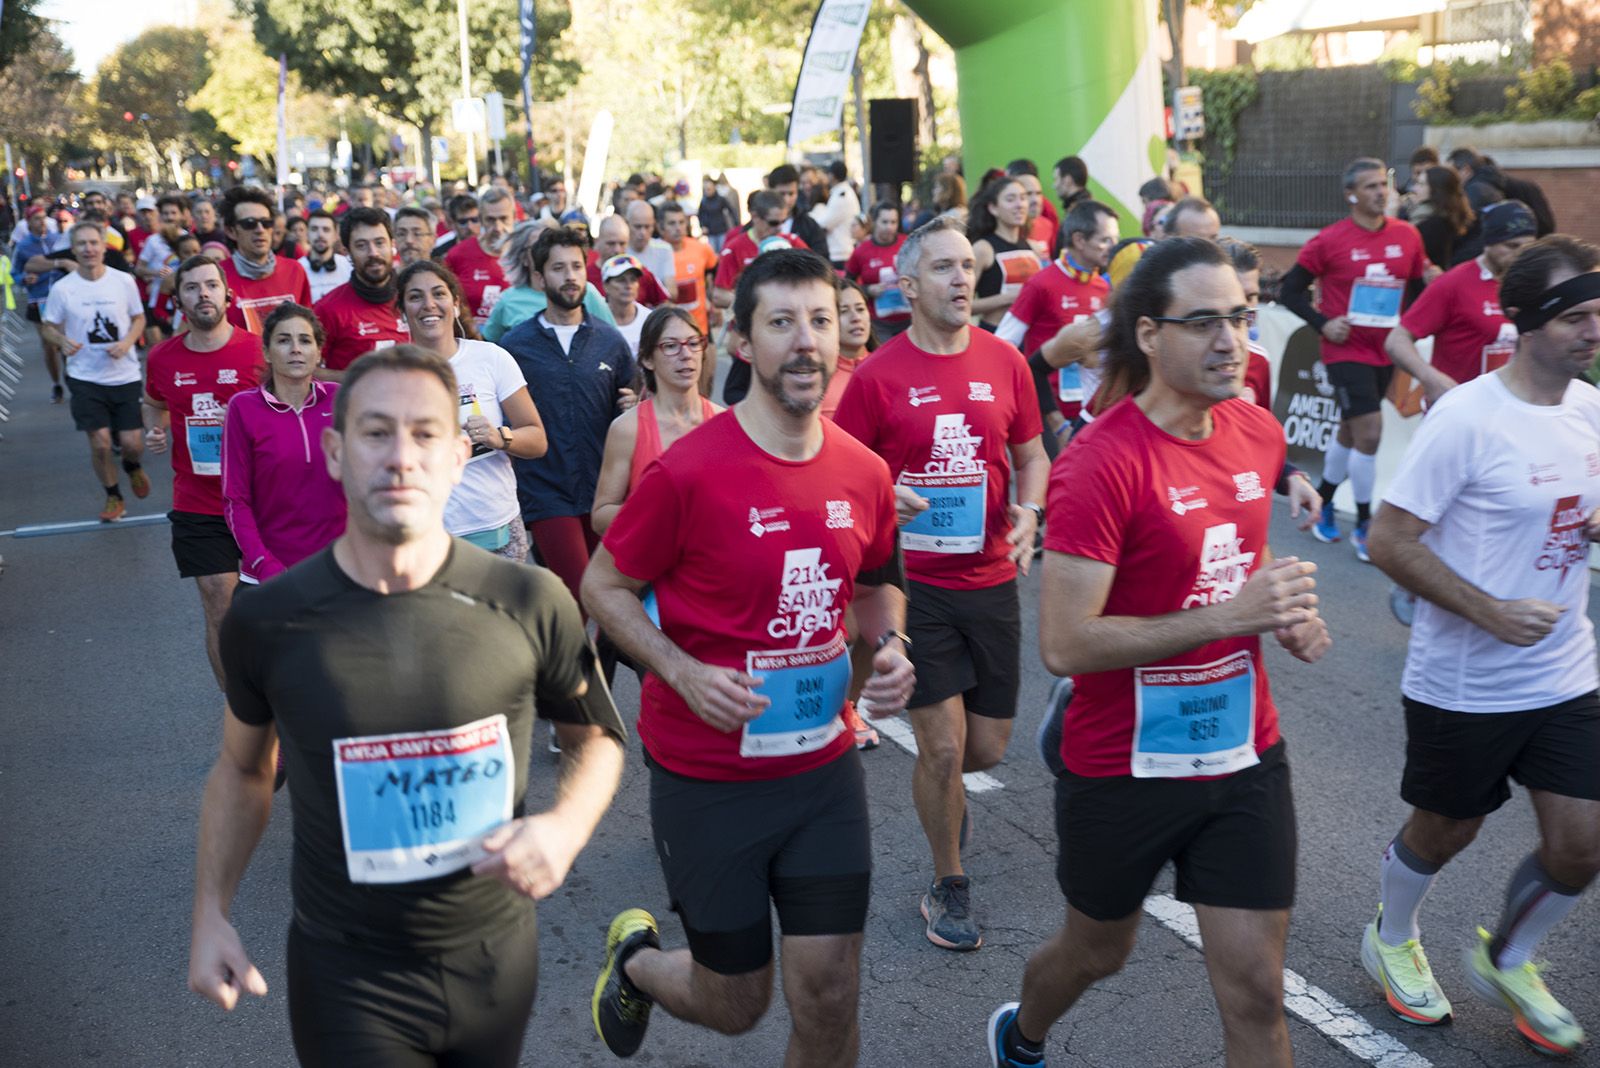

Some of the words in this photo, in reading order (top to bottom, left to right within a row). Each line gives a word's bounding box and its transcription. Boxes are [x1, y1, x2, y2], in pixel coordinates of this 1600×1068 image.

[1287, 393, 1342, 422] AMETLL
[930, 442, 981, 459] SANT
[923, 459, 987, 475] CUGAT
[929, 496, 966, 509] RISTIAN
[931, 512, 954, 528] 625
[787, 563, 831, 586] 21K
[777, 588, 839, 615] SANT
[767, 608, 842, 638] CUGAT
[795, 676, 825, 696] DANI
[391, 738, 431, 757] SANT
[376, 758, 502, 797] MATEO
[410, 799, 456, 830] 1184
